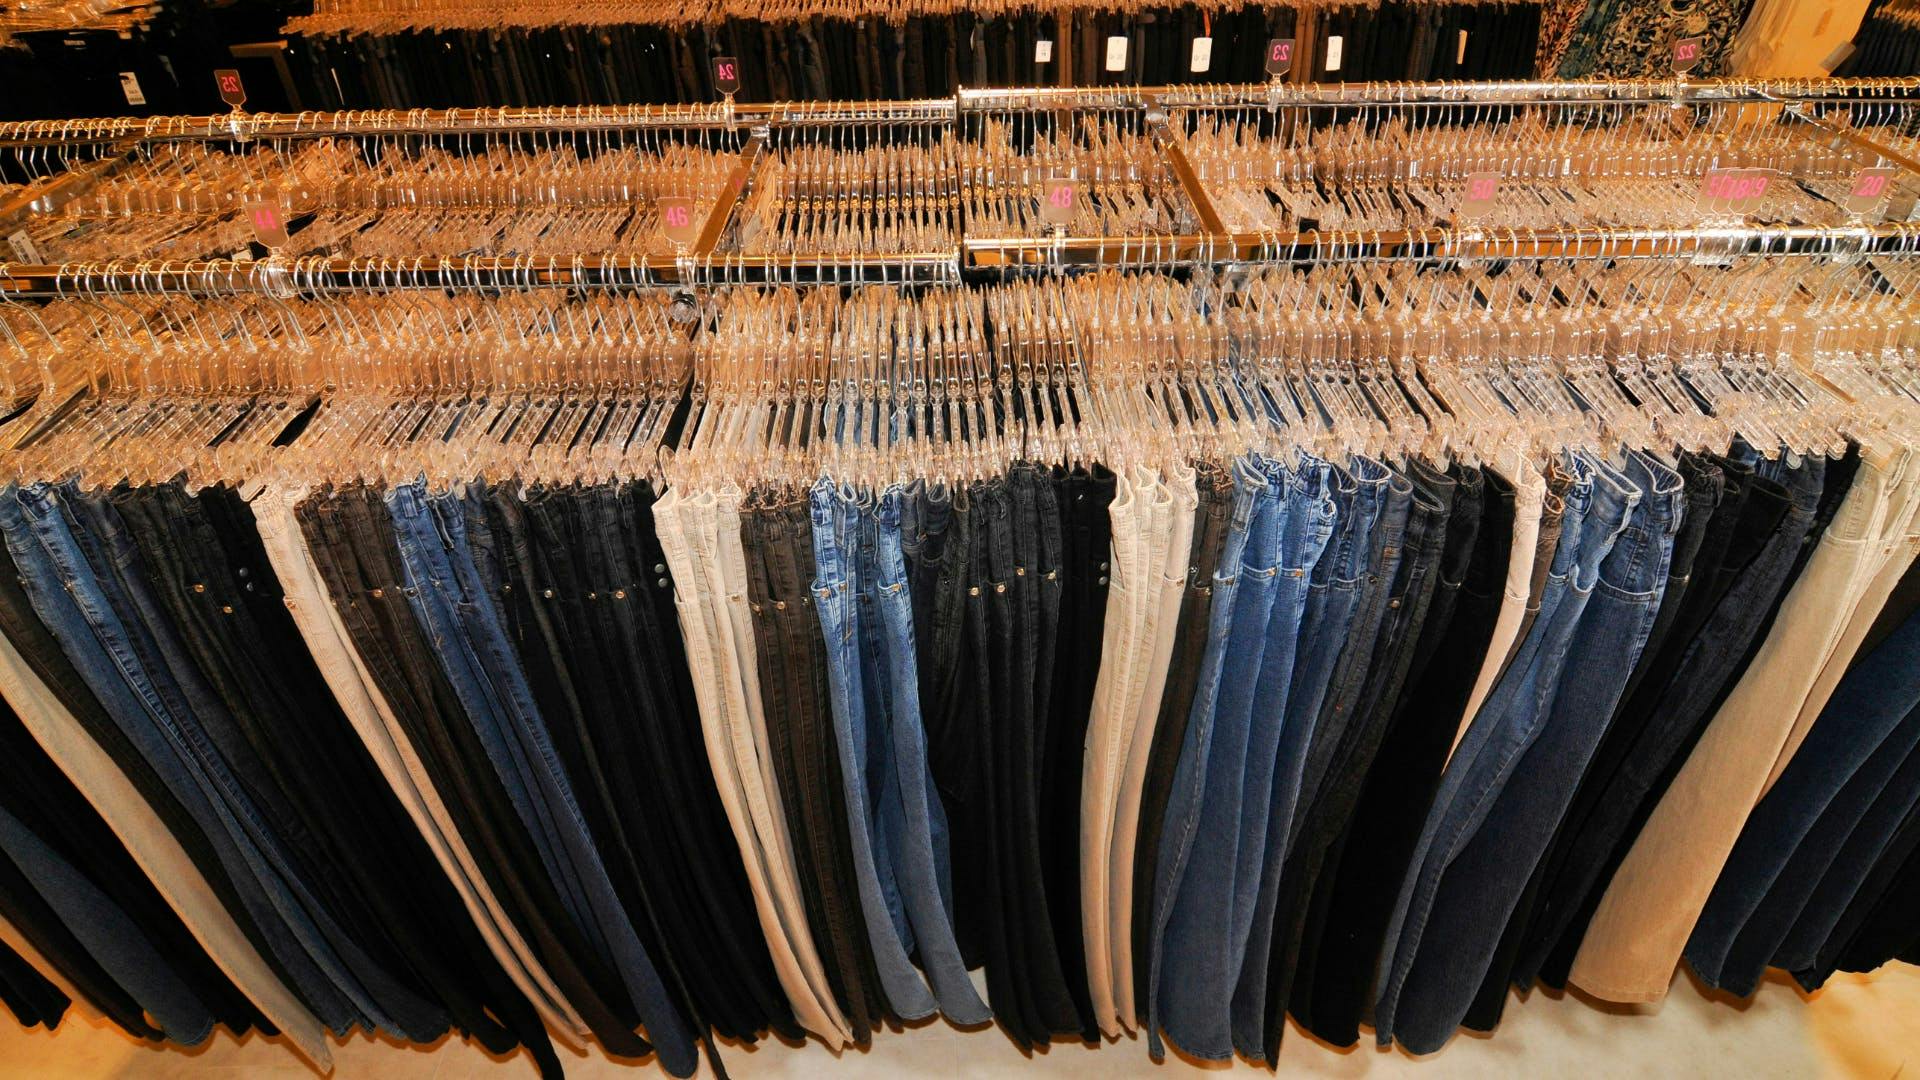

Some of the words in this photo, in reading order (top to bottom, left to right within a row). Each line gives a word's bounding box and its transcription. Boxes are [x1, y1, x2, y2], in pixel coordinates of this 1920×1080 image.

[1049, 185, 1072, 208] 48
[1470, 179, 1496, 201] 50
[1856, 175, 1885, 197] 20
[666, 206, 689, 227] 46
